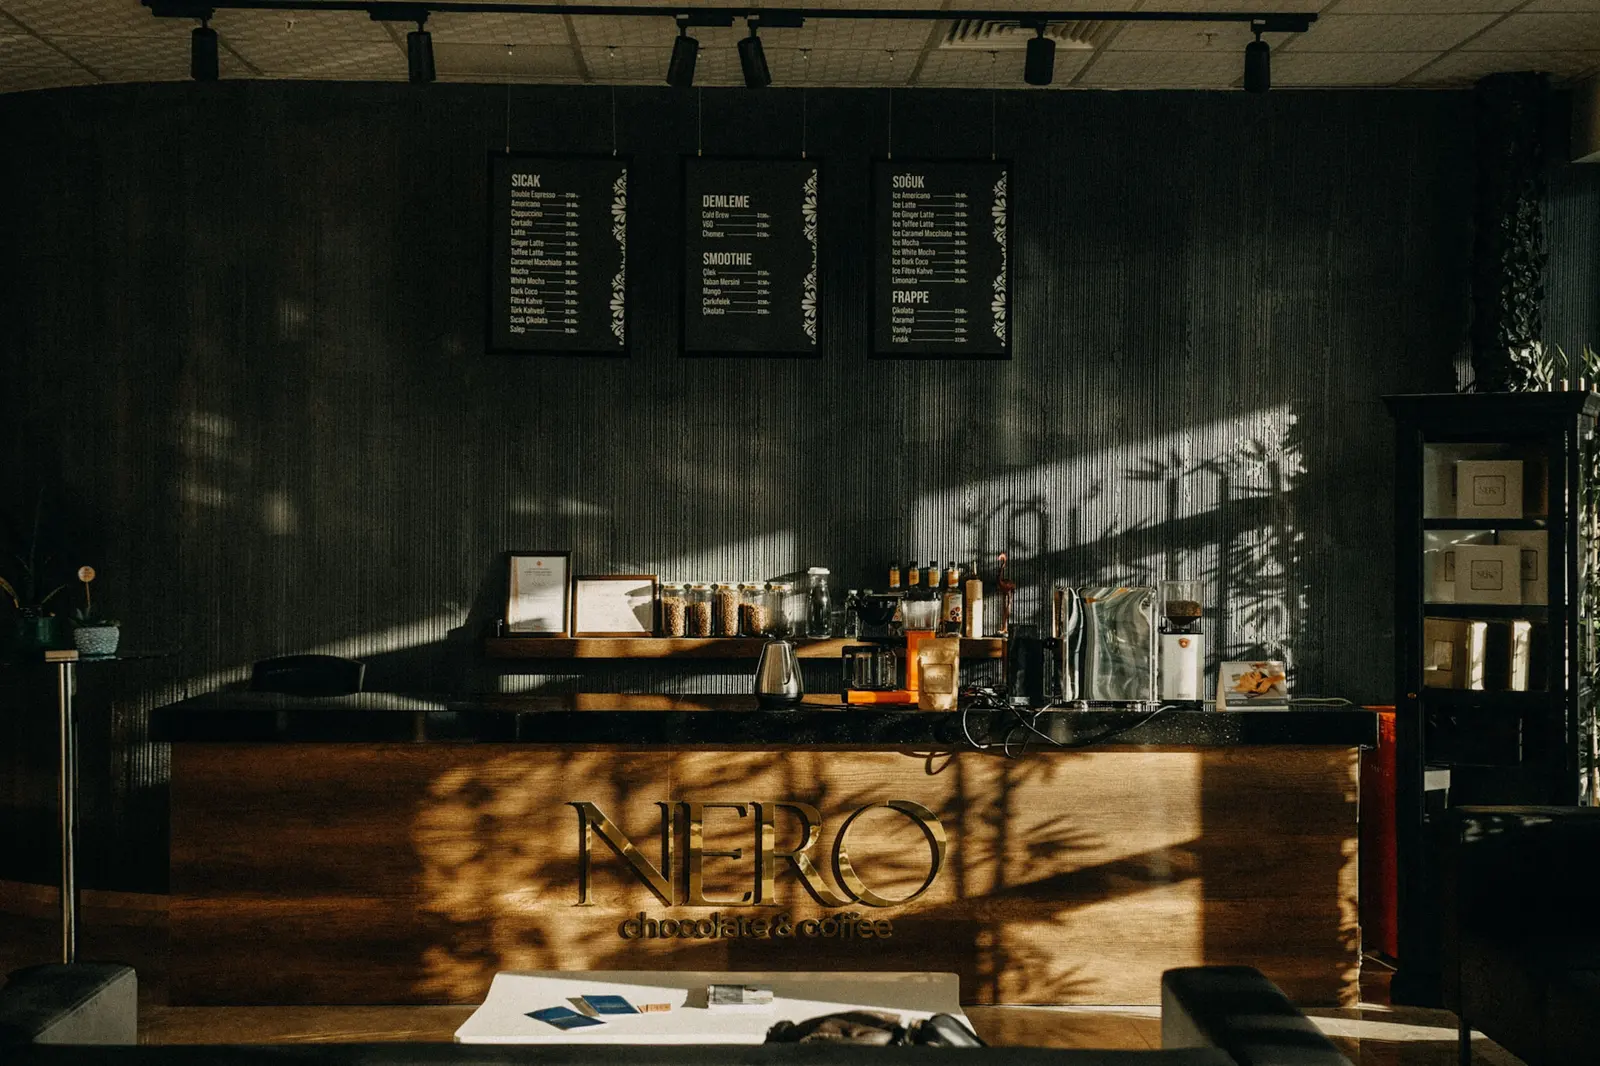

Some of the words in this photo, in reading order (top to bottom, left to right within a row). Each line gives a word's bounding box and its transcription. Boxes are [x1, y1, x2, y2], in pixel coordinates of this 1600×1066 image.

[511, 174, 540, 187] SICAK
[893, 173, 925, 188] SOĞUK
[703, 195, 750, 208] DEMLEME
[511, 228, 526, 236] Latte
[703, 252, 752, 266] SMOOTHIE
[893, 291, 929, 303] FRAPPE
[566, 800, 947, 908] NERO
[618, 911, 772, 939] chocolate
[774, 911, 796, 939] &
[802, 911, 893, 939] coffee
